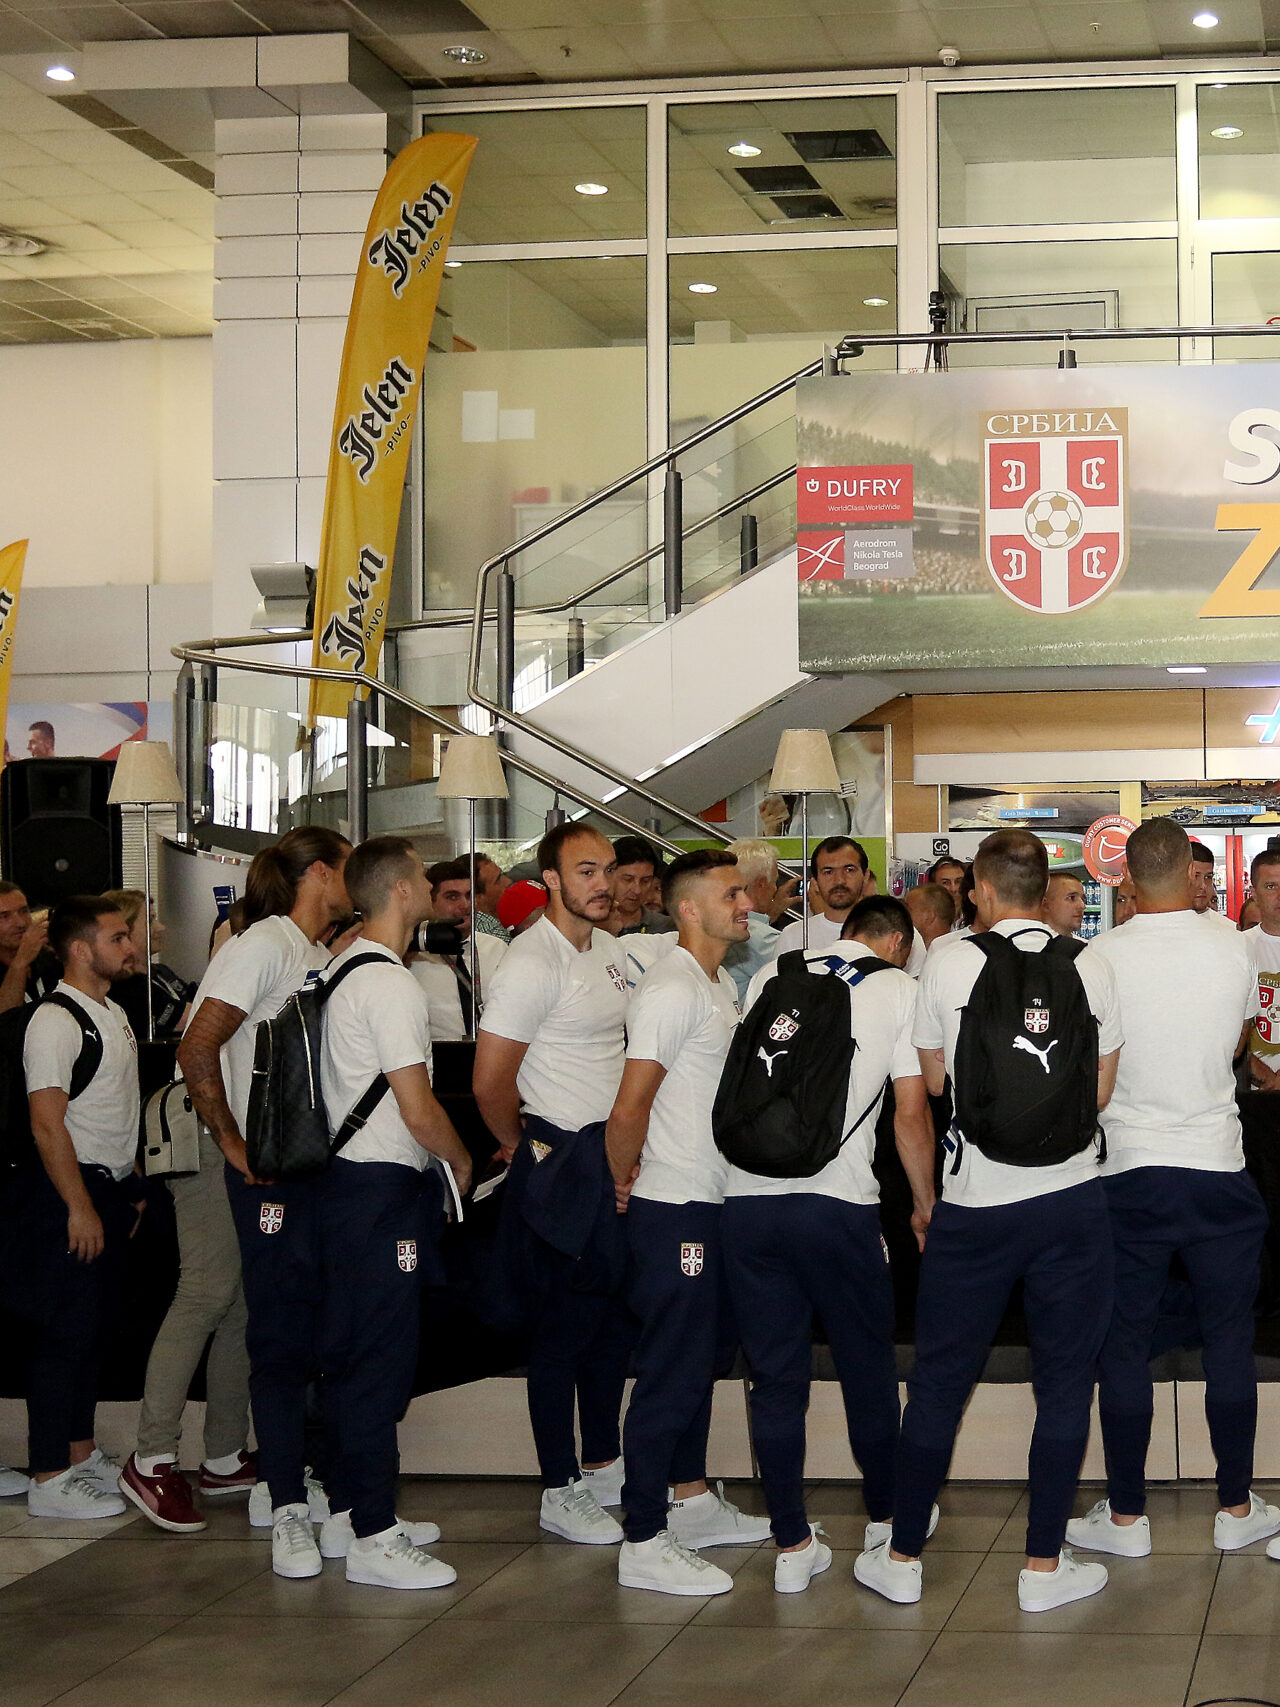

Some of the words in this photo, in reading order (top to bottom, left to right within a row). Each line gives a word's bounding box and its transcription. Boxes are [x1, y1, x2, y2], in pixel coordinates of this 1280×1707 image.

[368, 181, 453, 299] Jelen
[339, 357, 416, 484] Jelen
[987, 412, 1119, 435] СРБИЈА
[827, 478, 902, 498] DUFRY
[853, 540, 897, 548] Aerodrom
[853, 551, 880, 559] Nikola
[882, 550, 903, 558] Tesla
[853, 561, 889, 571] Beograd
